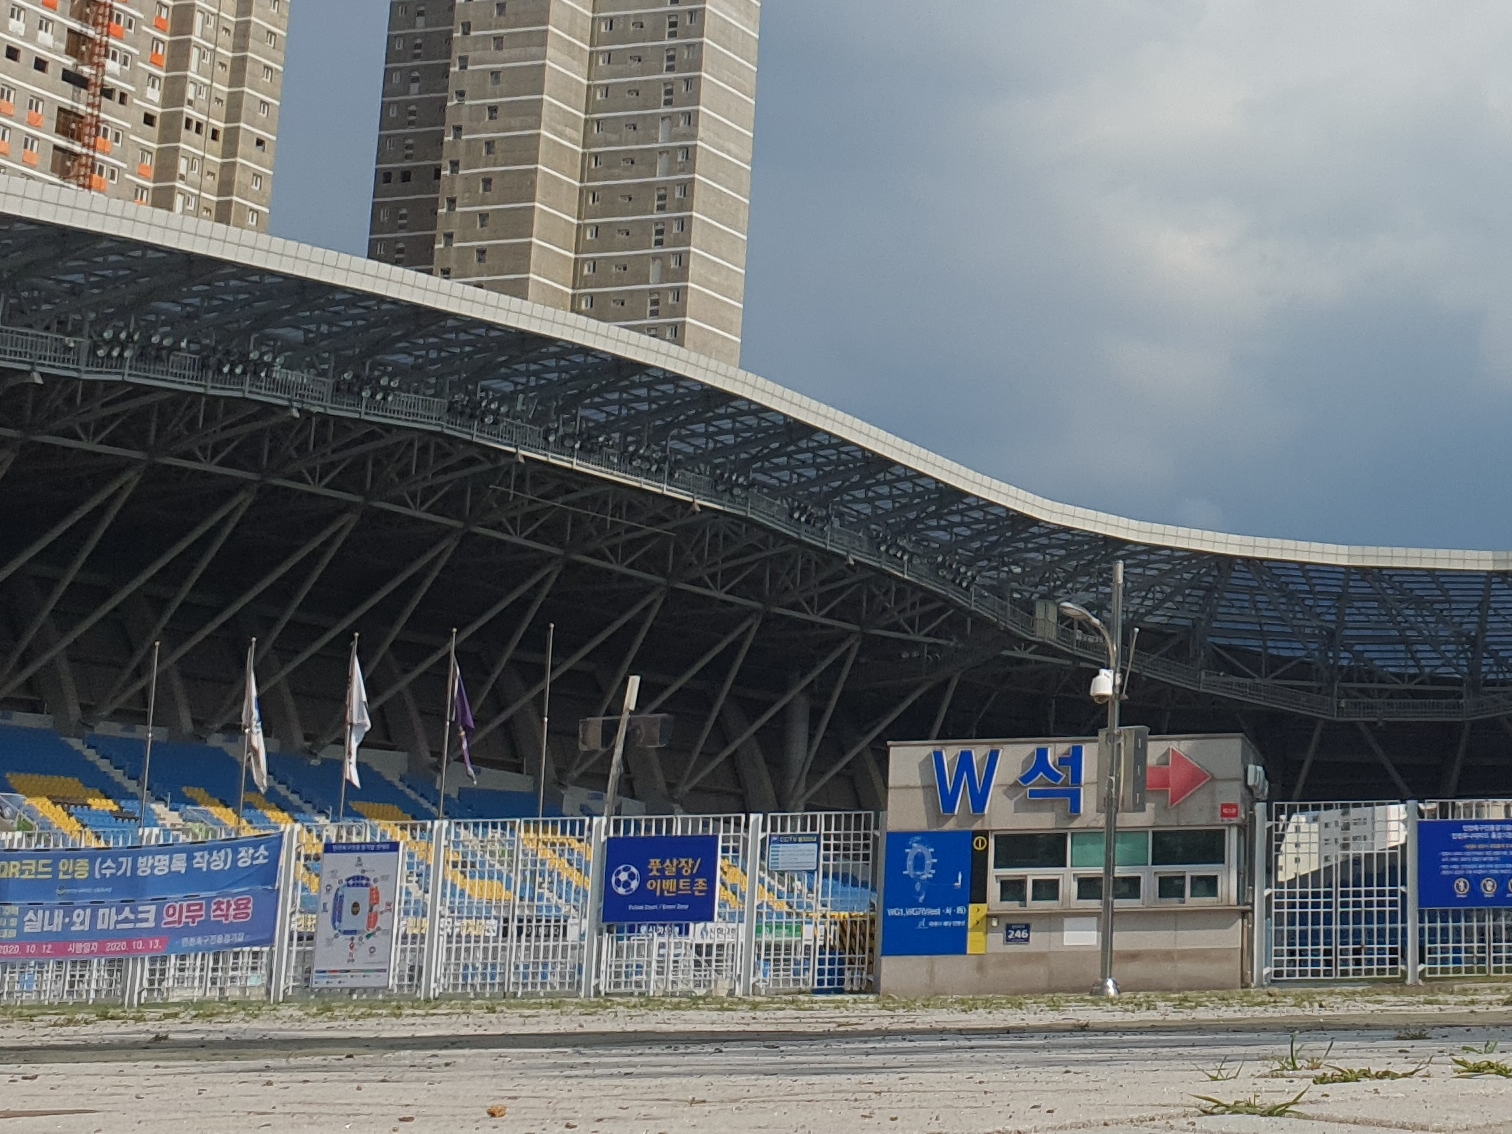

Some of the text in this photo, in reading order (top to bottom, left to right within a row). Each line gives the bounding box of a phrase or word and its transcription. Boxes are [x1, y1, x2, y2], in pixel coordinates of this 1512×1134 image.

[931, 745, 1084, 816] W 석
[0, 844, 270, 880] QR코드 인증 (수기 방명록 작성) 장소
[647, 857, 702, 877] 풋살장/
[646, 878, 709, 897] 이벤트존
[23, 908, 91, 933] 실내·외
[97, 904, 157, 931] 마스크
[161, 901, 205, 929] 의무
[211, 896, 254, 924] 착용
[1007, 929, 1029, 939] 246
